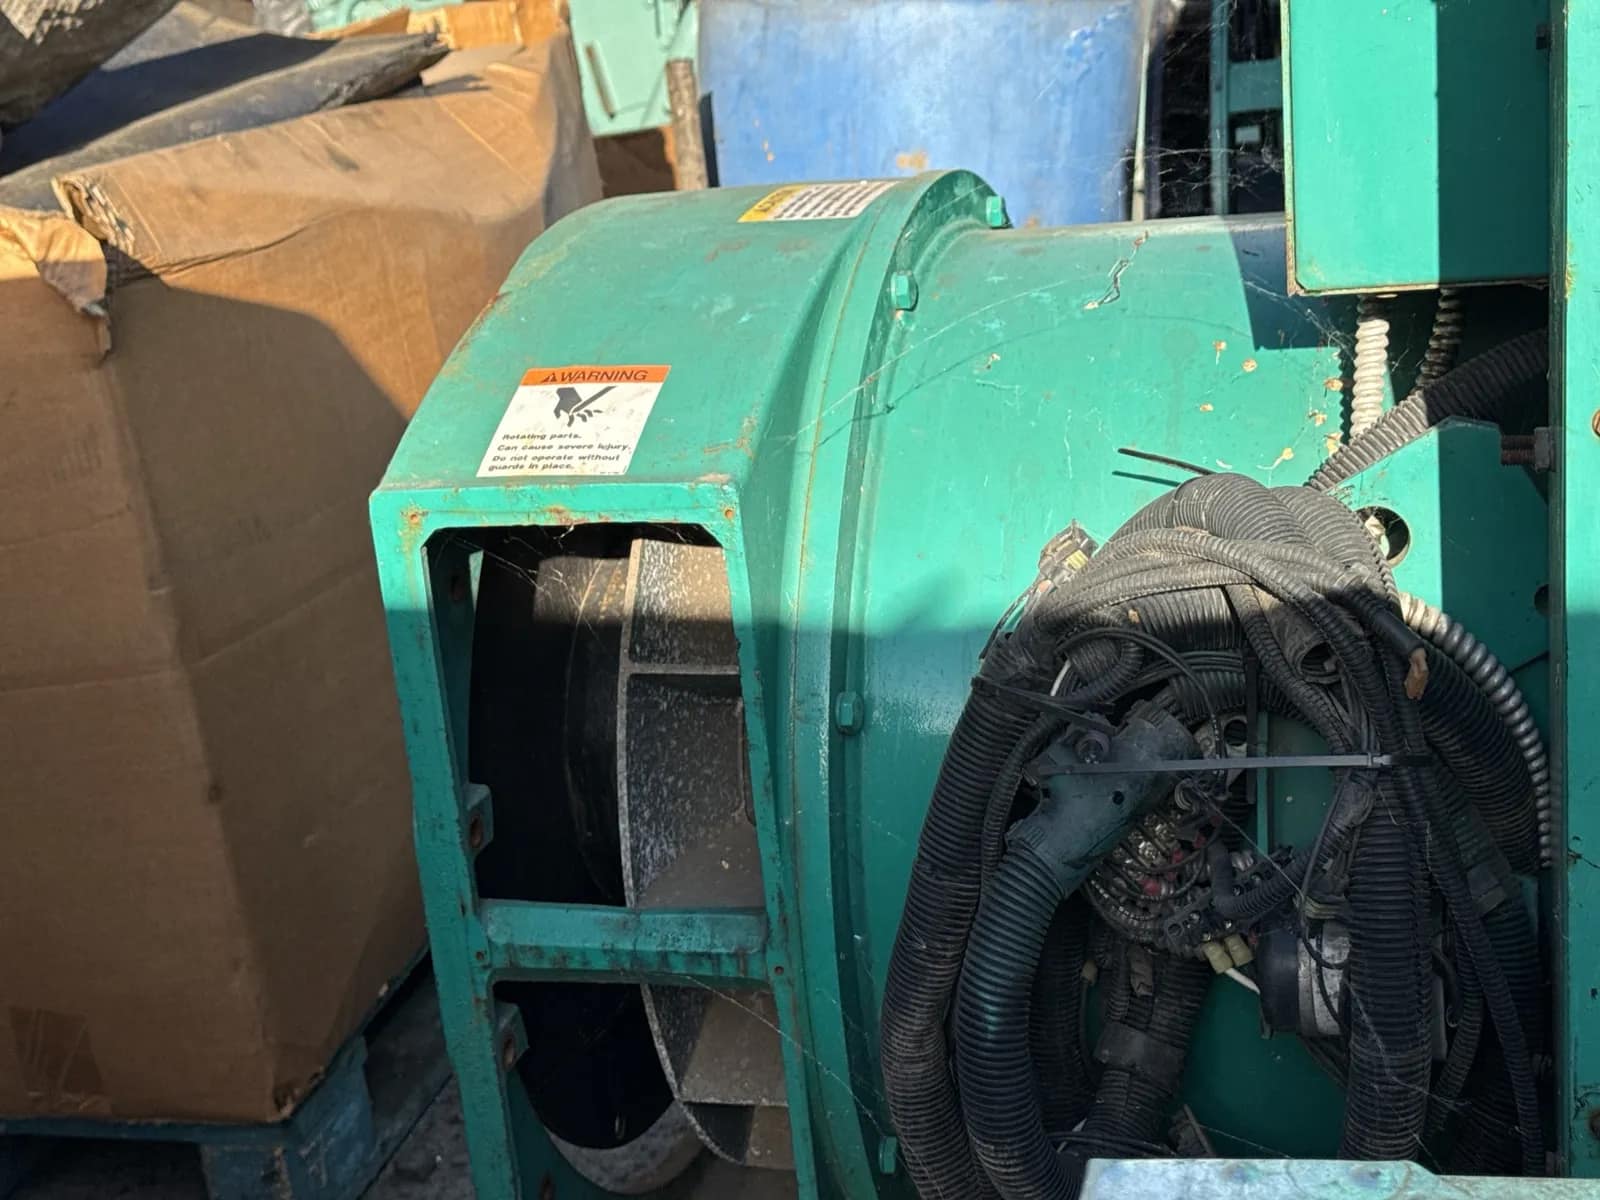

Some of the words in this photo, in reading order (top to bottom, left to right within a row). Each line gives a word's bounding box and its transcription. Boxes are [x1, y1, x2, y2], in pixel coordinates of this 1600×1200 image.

[560, 370, 649, 382] WARNING
[502, 432, 546, 440] Rotating
[531, 454, 574, 463] operate
[488, 463, 525, 471] guards
